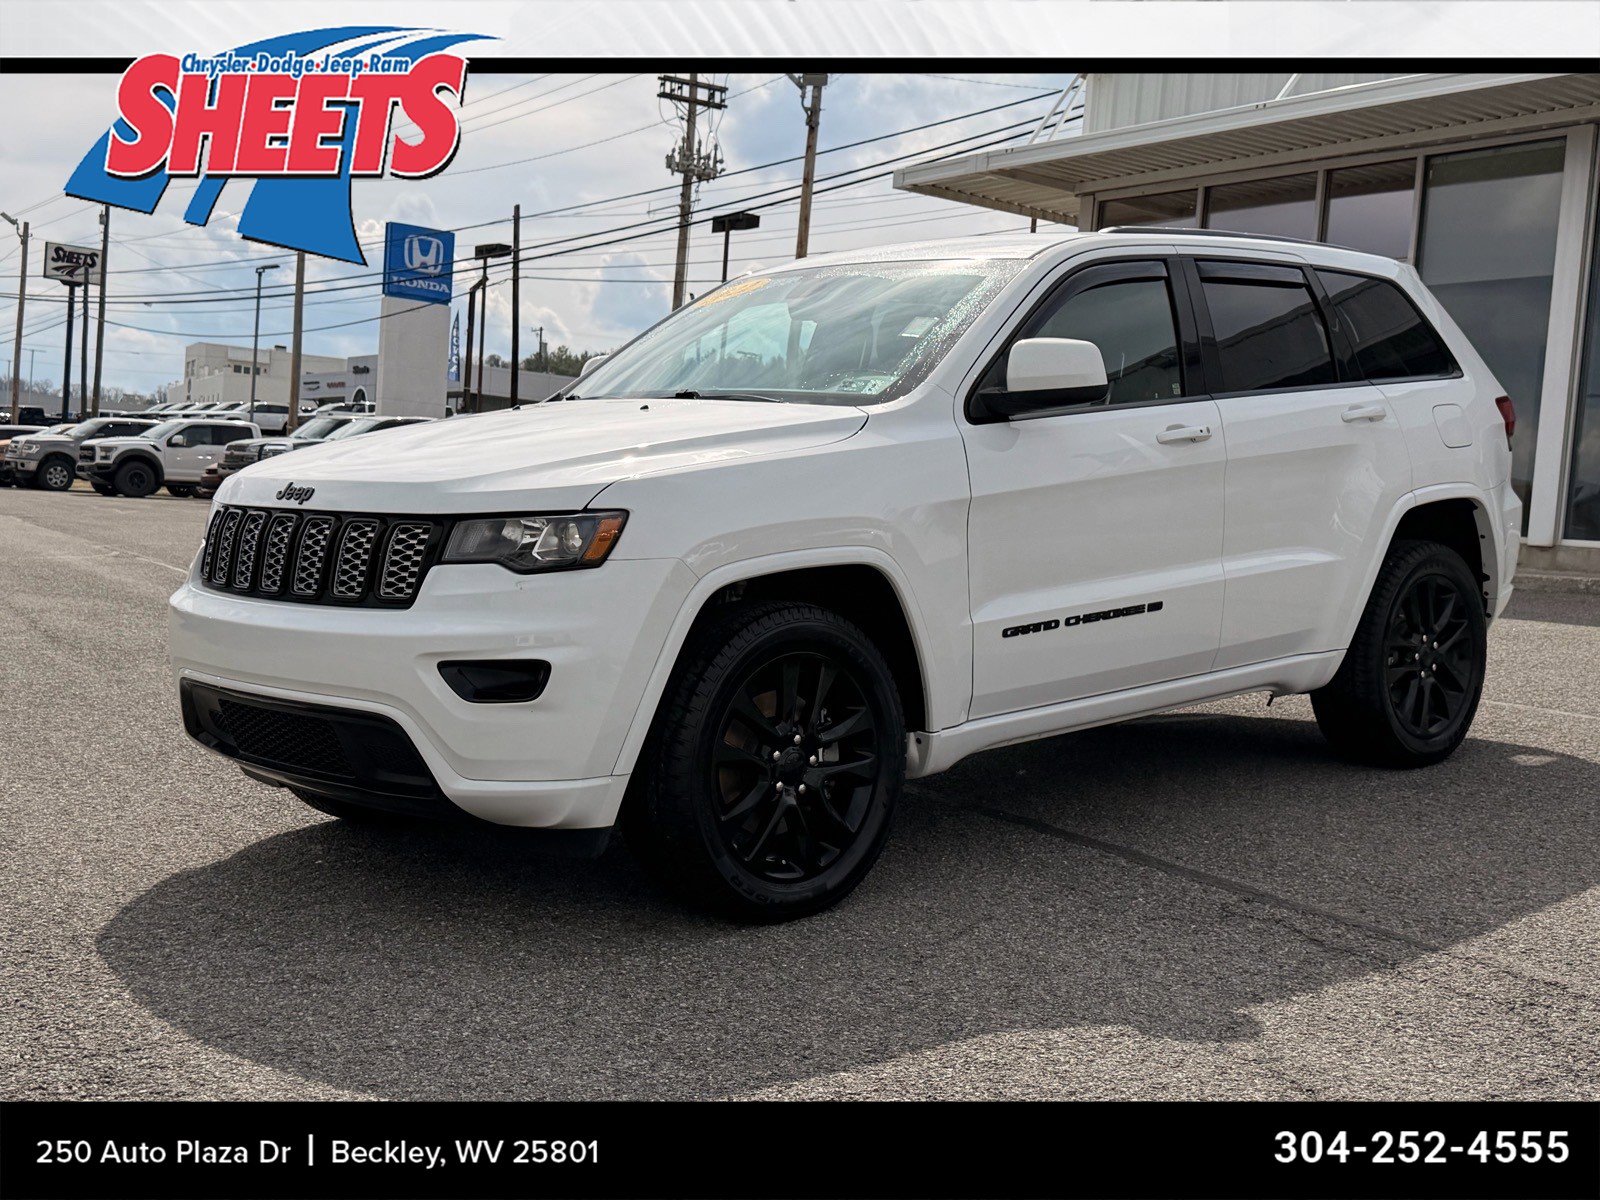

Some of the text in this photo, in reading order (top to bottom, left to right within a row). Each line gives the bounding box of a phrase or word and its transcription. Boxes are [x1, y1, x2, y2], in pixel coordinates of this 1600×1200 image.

[51, 246, 99, 268] SHEETS
[392, 275, 450, 293] HONDA
[276, 481, 315, 505] Jeep
[1002, 619, 1060, 638] GRAND
[1065, 604, 1146, 627] CHEROKEE
